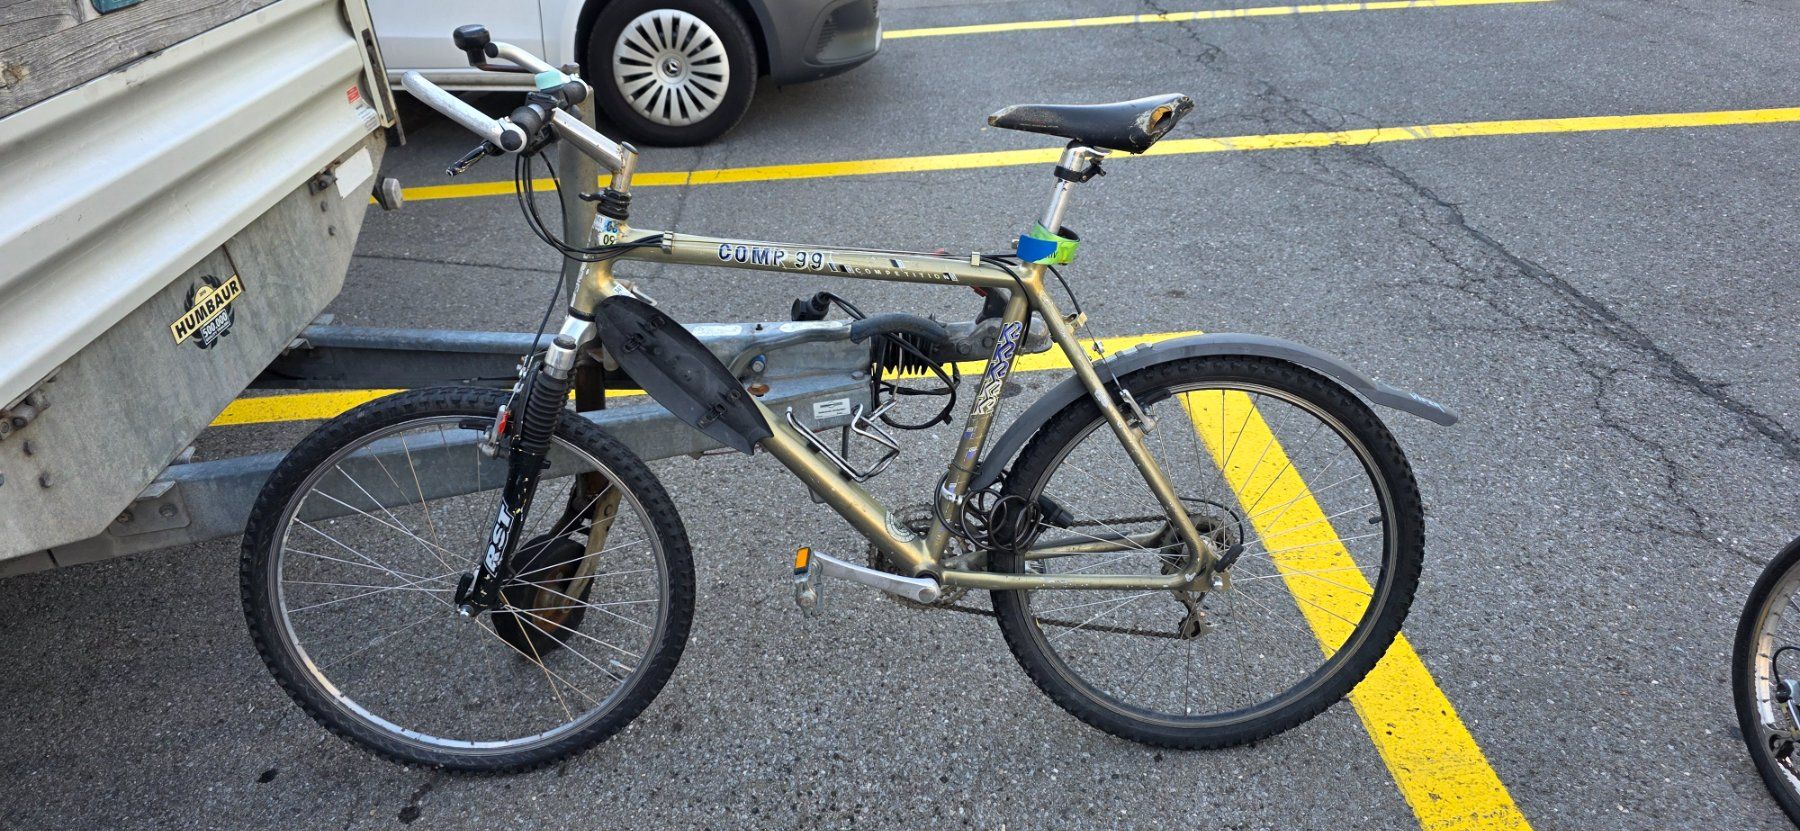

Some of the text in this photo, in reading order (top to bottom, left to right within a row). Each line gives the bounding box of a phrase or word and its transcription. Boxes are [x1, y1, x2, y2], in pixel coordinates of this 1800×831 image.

[718, 243, 825, 271] COMP 99
[854, 267, 951, 281] COMPETITION
[174, 280, 239, 339] HUMBAUR
[202, 312, 228, 338] 500.000
[484, 500, 512, 575] RST
